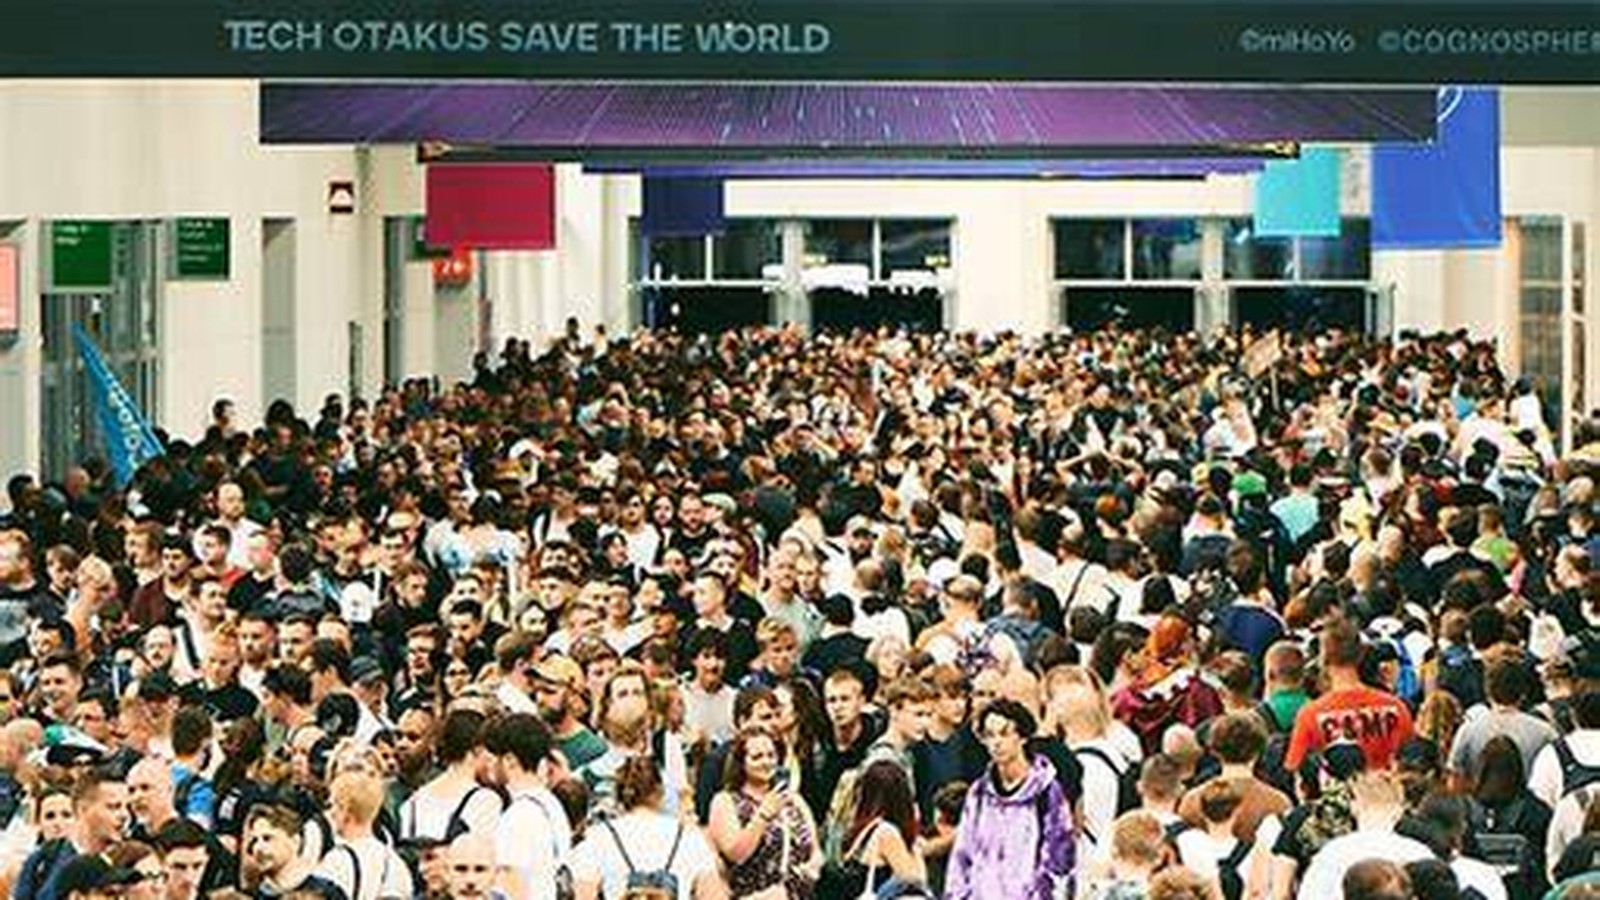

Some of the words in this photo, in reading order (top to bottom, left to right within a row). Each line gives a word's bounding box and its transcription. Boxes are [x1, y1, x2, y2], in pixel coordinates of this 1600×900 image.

[224, 20, 322, 50] TECH
[333, 20, 489, 51] OTAKUS
[500, 21, 598, 51] SAVE
[610, 22, 682, 51] THE
[695, 21, 830, 52] WORLD
